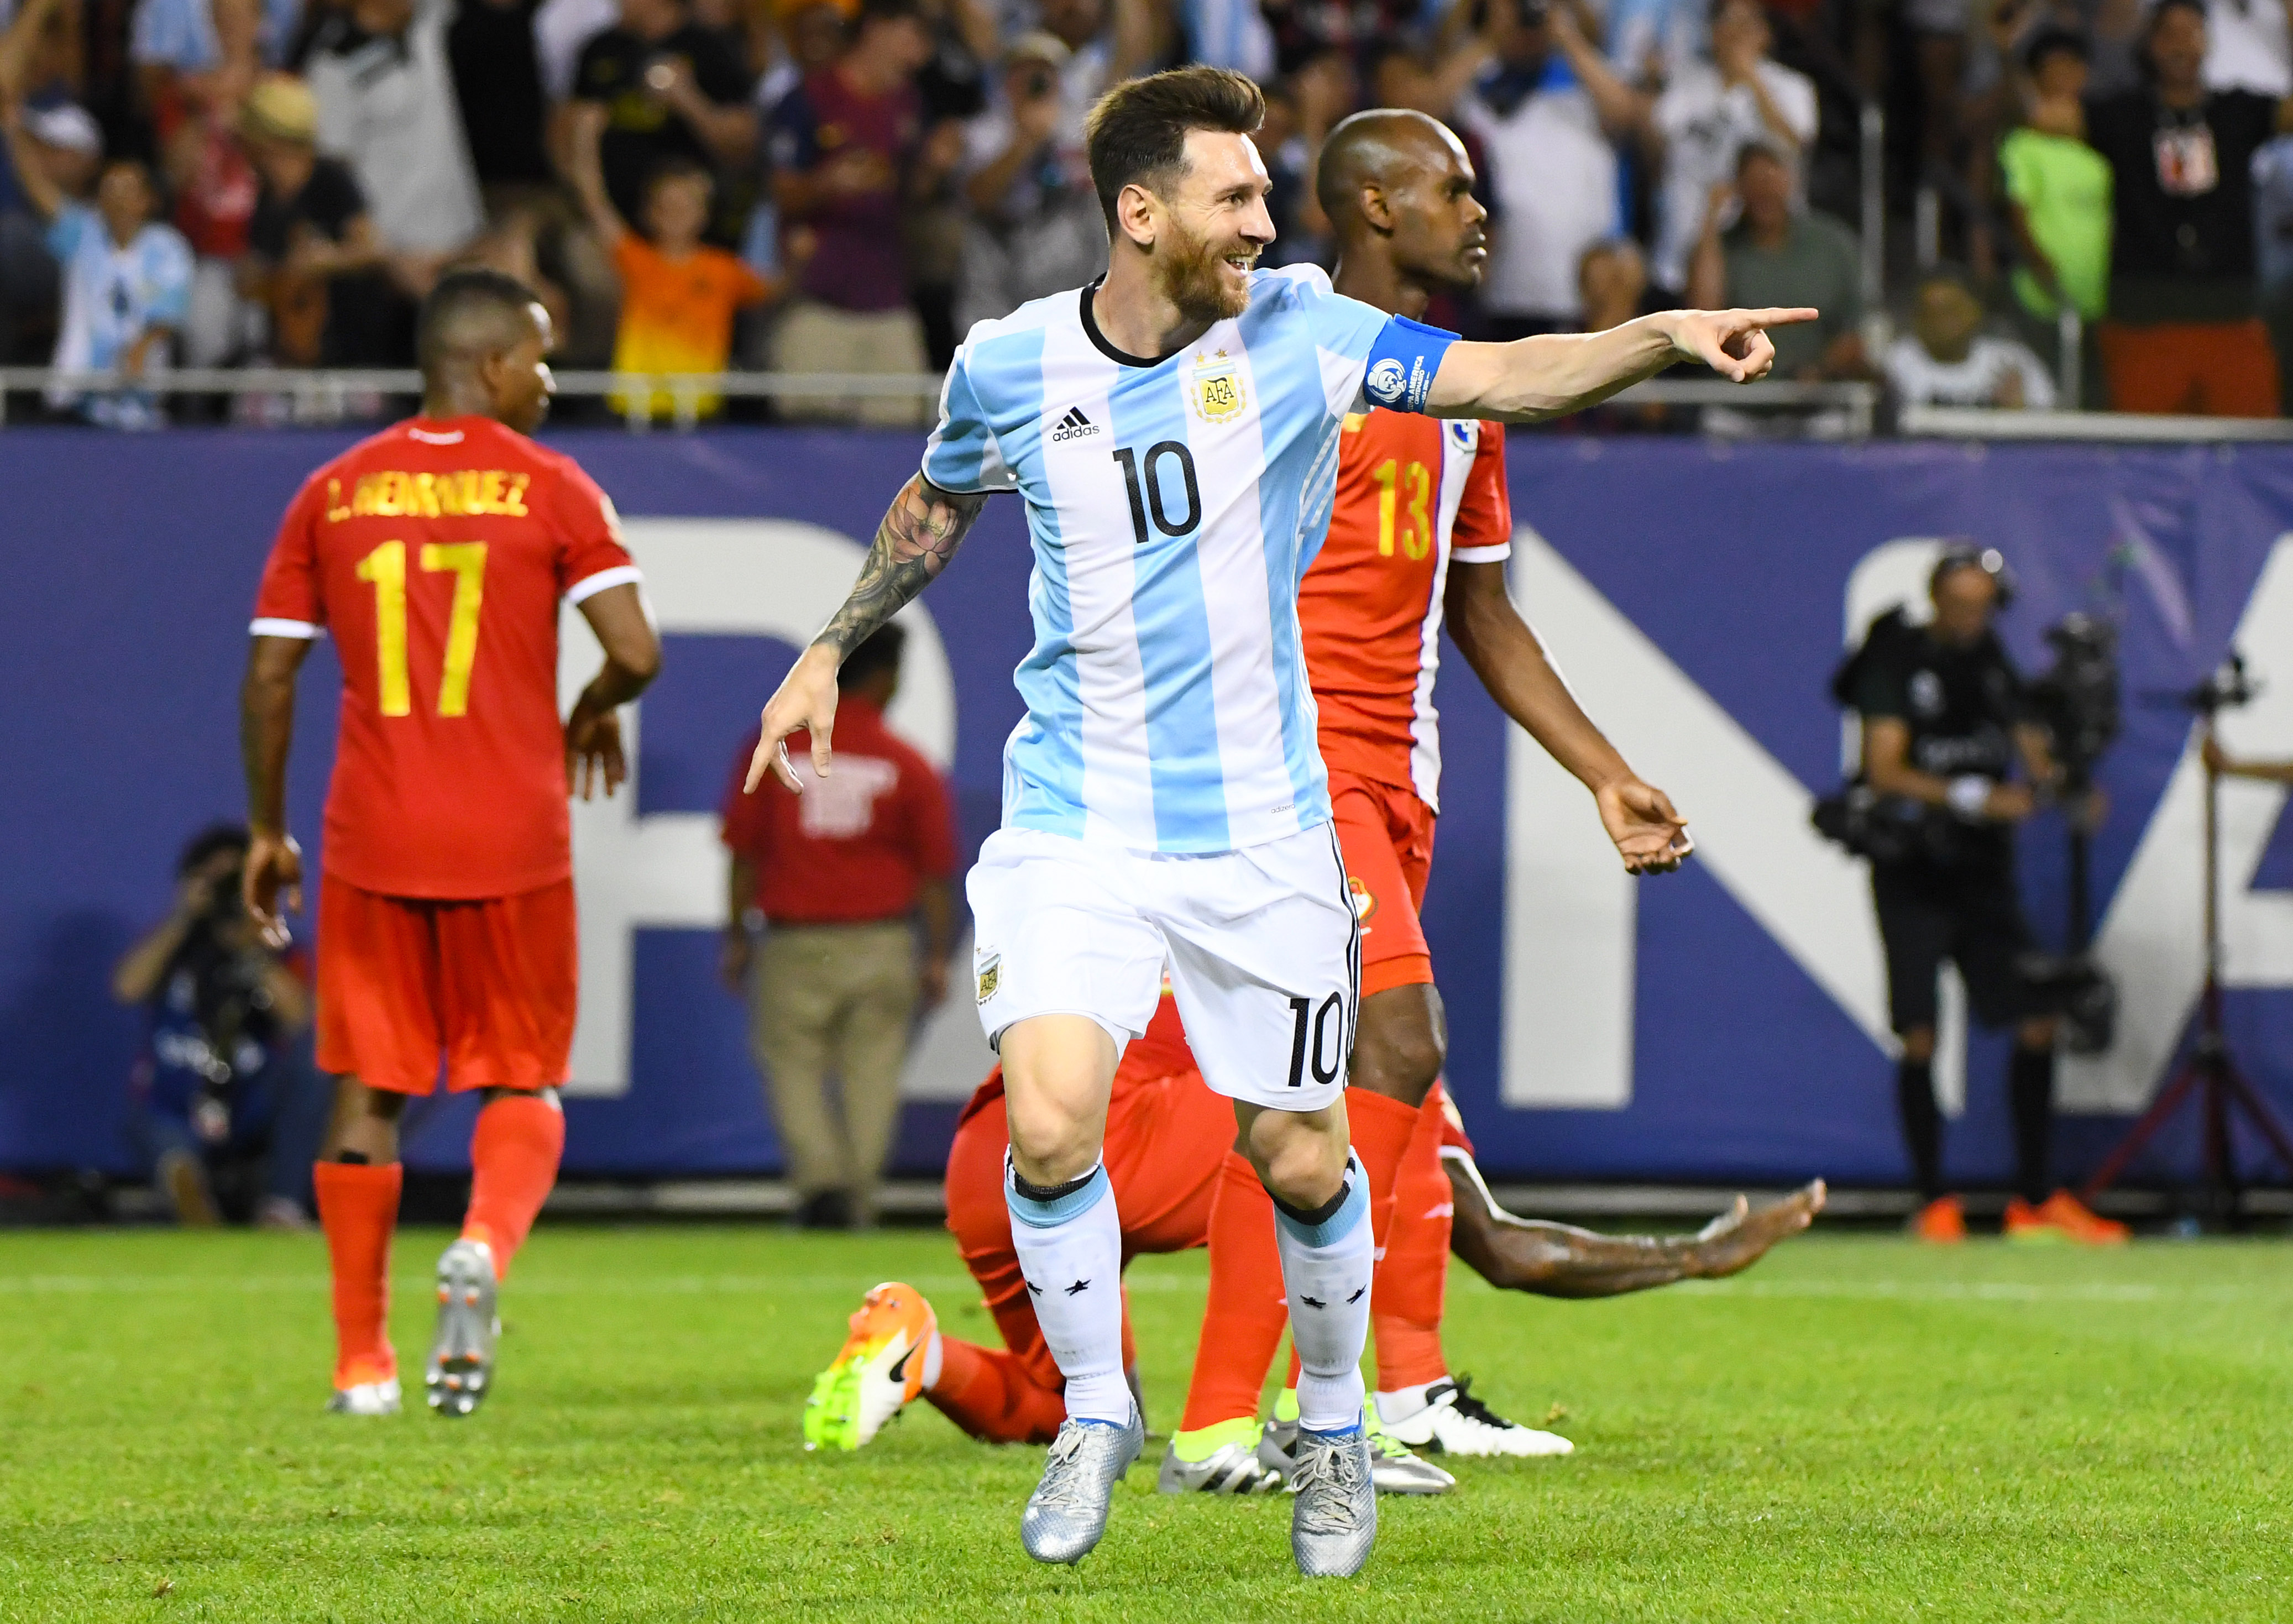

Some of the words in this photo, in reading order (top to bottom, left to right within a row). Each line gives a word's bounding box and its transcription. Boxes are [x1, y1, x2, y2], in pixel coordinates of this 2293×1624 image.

[1206, 377, 1234, 405] AFA
[1409, 355, 1425, 395] AMERICA
[1053, 425, 1100, 442] adidas
[1112, 440, 1202, 544] 10
[1374, 458, 1431, 560] 13
[355, 539, 488, 717] 17
[1270, 803, 1296, 814] adizero
[1288, 991, 1343, 1087] 10
